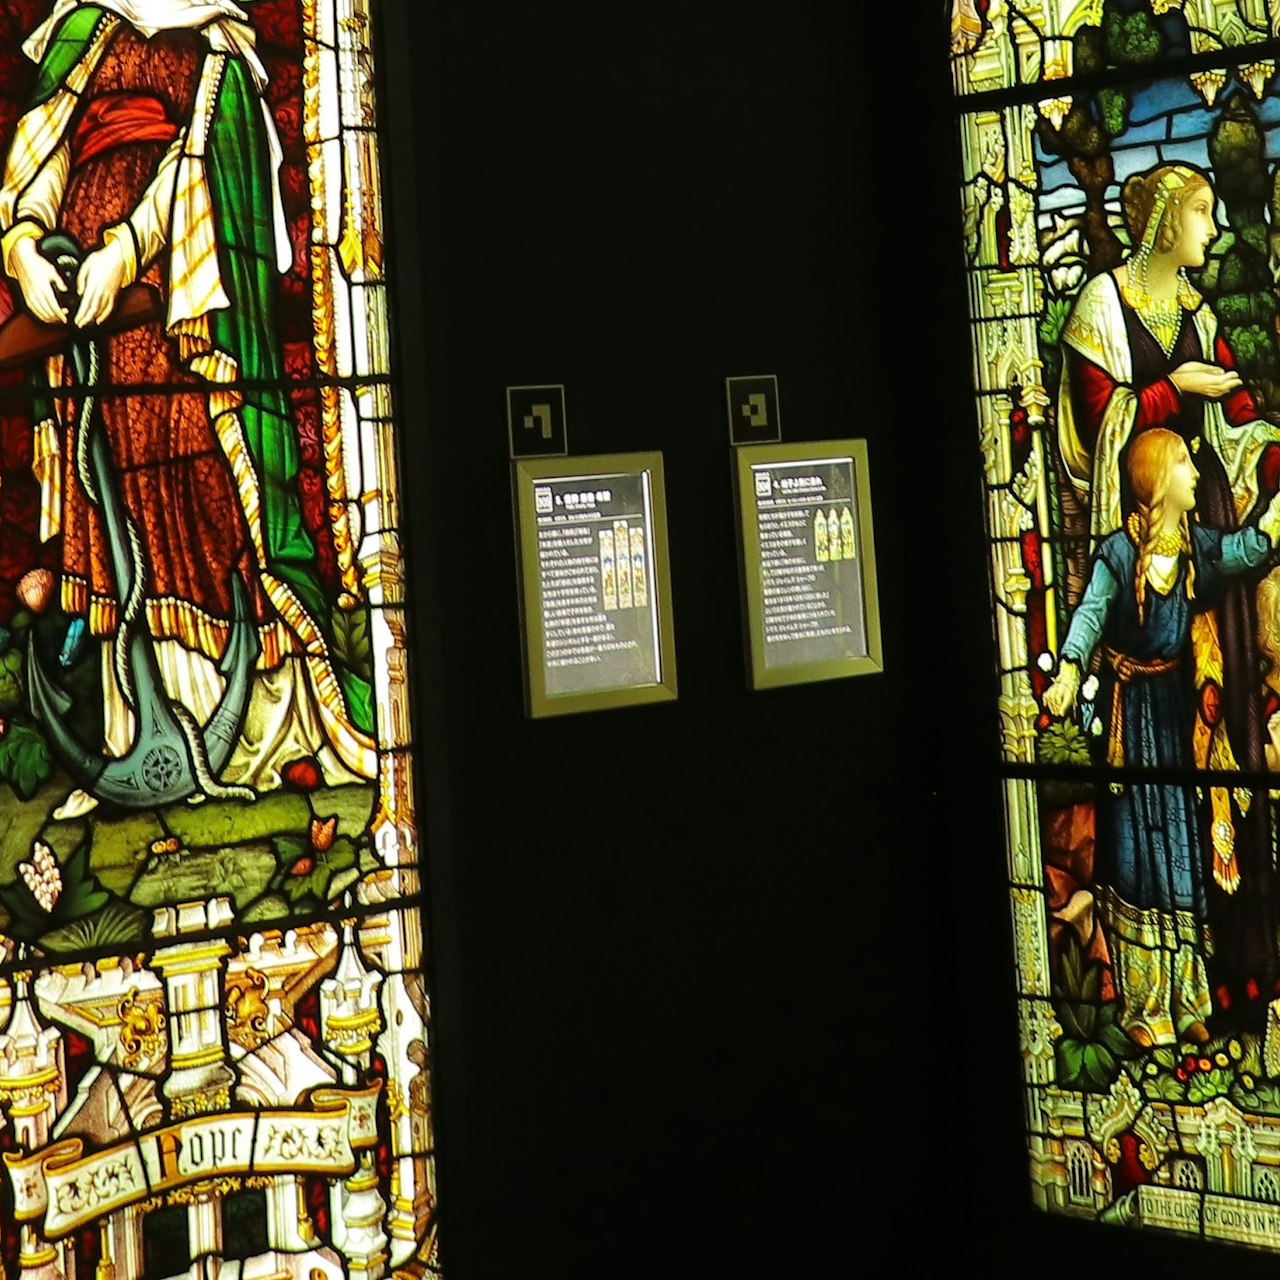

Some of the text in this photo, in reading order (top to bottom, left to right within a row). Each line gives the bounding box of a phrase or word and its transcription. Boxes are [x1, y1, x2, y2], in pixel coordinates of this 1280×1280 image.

[1141, 1197, 1153, 1213] TO
[1155, 1199, 1172, 1217] THE
[1205, 1207, 1218, 1223] OF
[1220, 1209, 1241, 1227] GOD
[1253, 1213, 1265, 1232] IN
